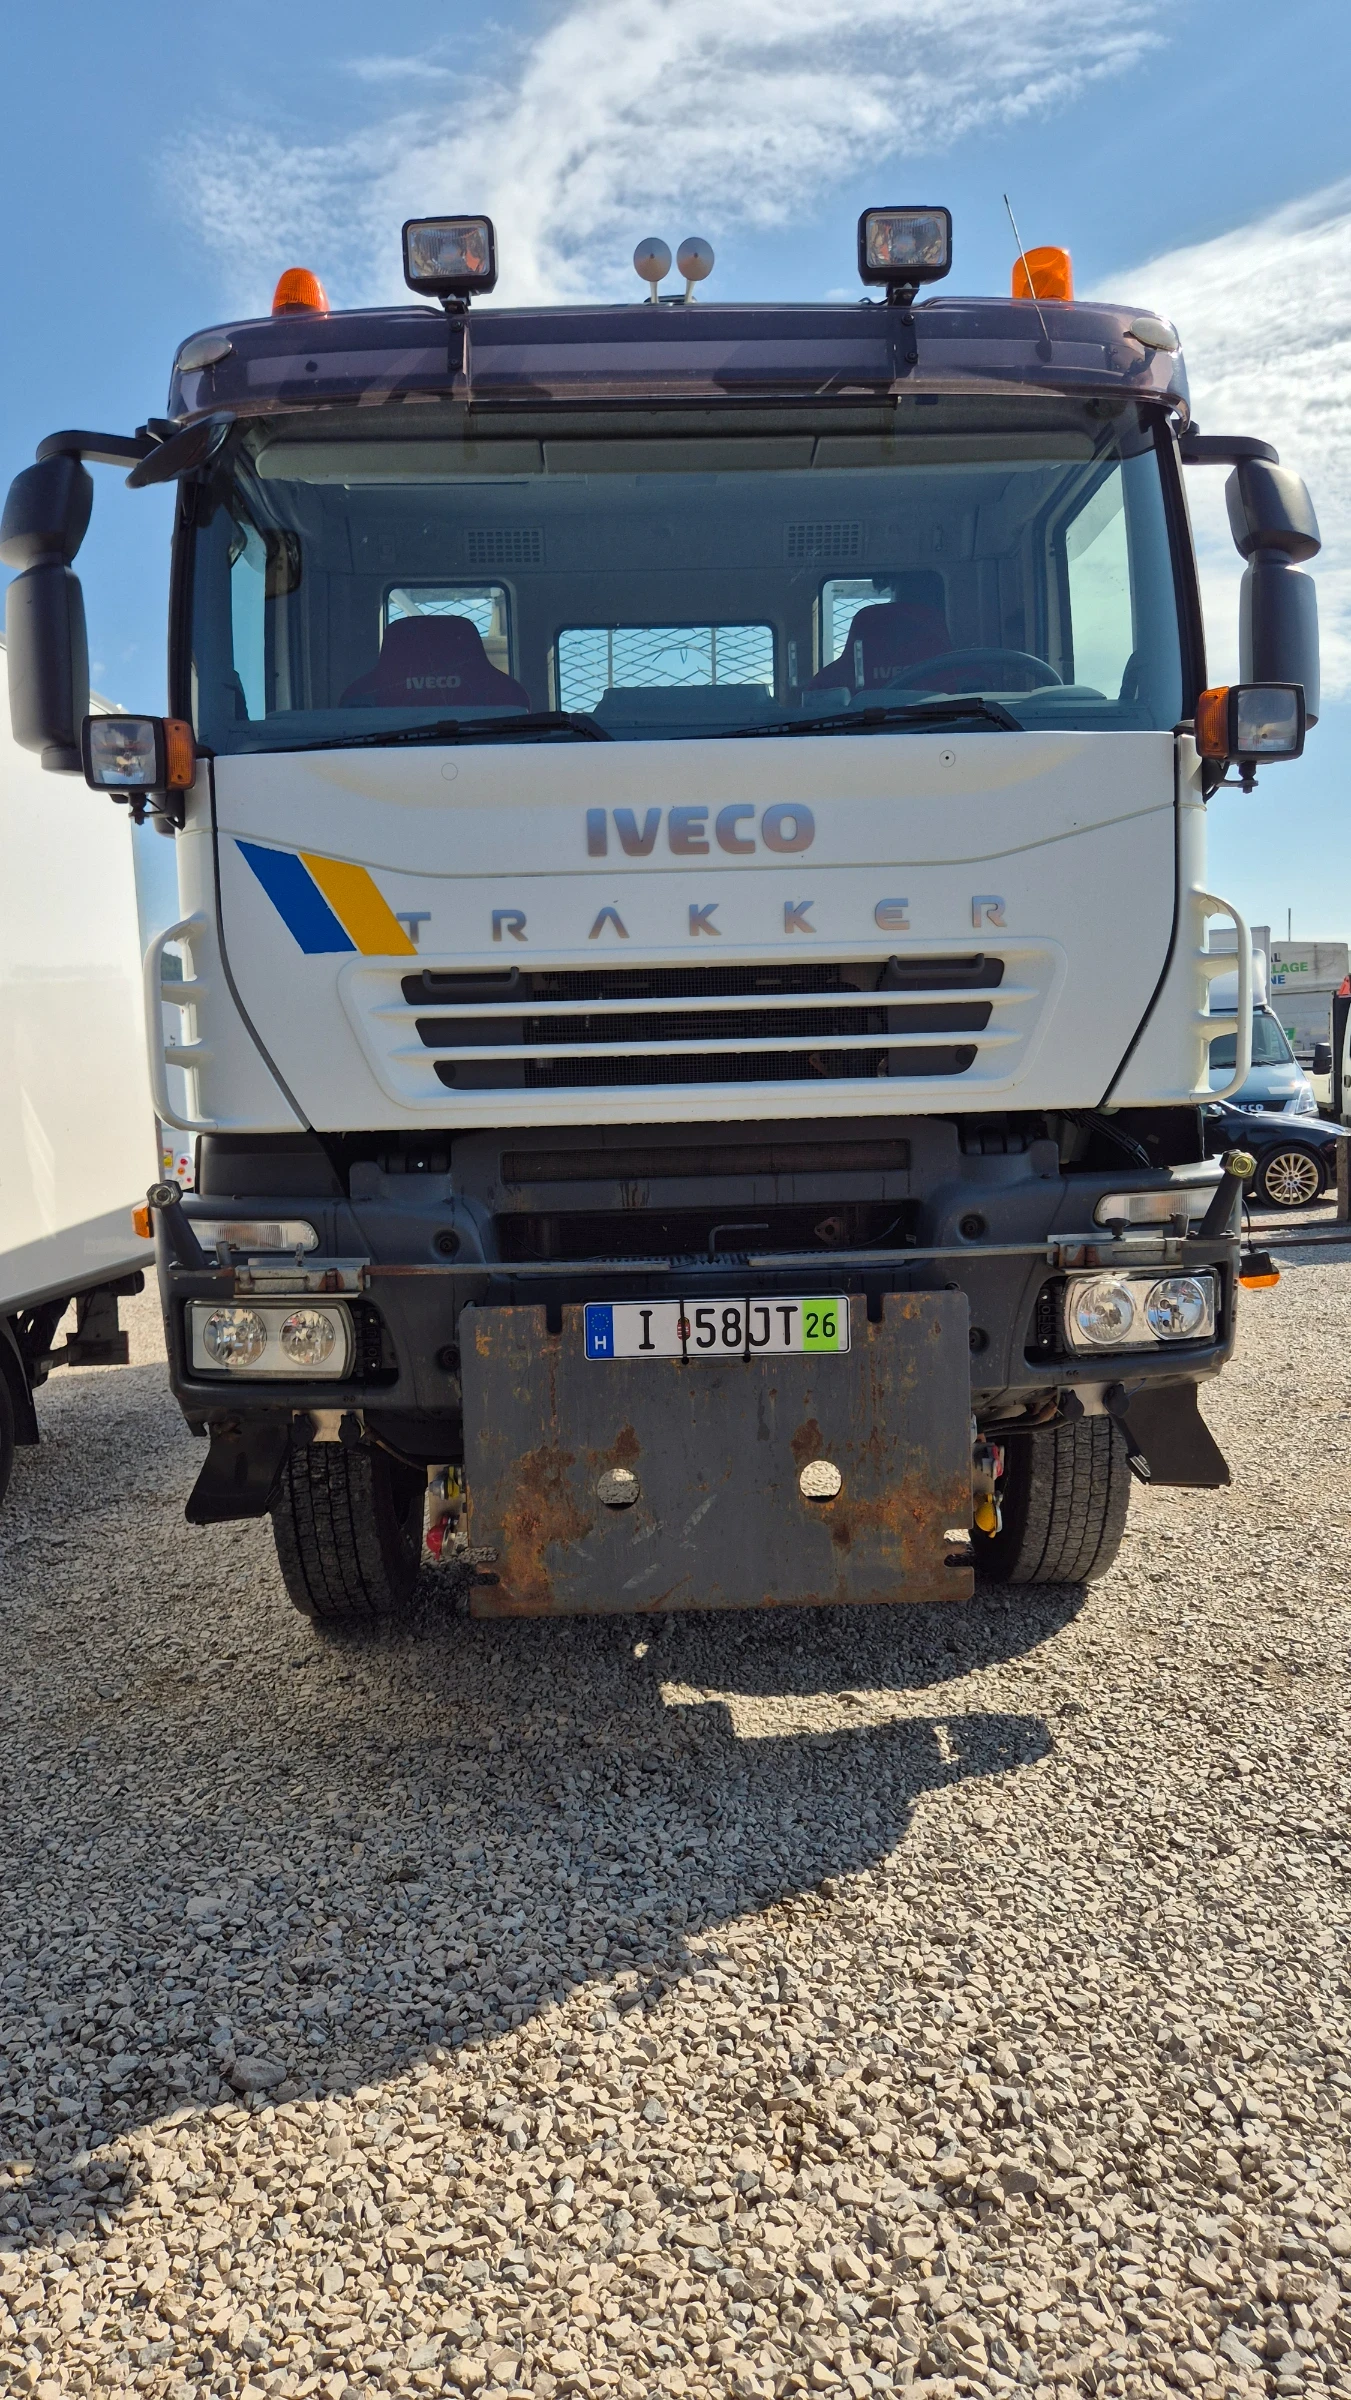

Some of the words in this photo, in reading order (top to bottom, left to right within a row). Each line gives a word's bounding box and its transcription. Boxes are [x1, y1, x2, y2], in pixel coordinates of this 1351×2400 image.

[406, 675, 461, 689] IVECO
[586, 803, 816, 857] IVECO
[395, 895, 1007, 944] TRAKKER
[1271, 962, 1308, 974] LAGE
[805, 1312, 836, 1338] 26
[594, 1335, 607, 1350] H
